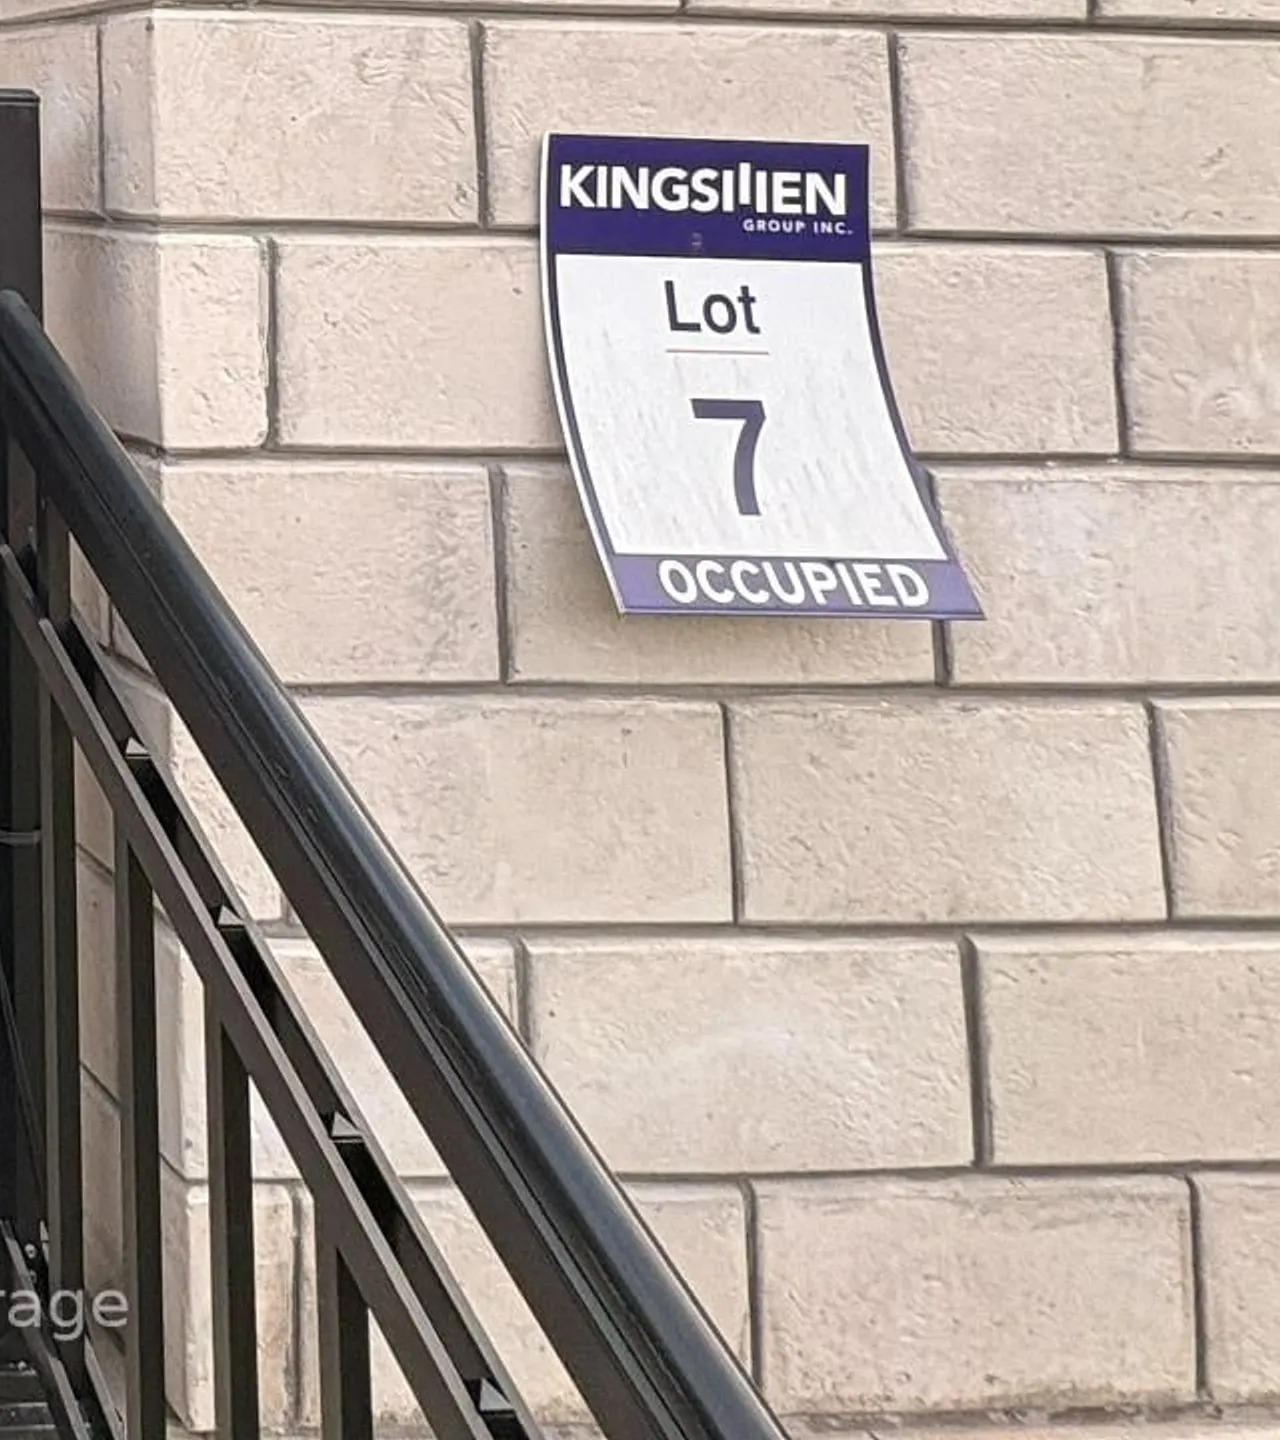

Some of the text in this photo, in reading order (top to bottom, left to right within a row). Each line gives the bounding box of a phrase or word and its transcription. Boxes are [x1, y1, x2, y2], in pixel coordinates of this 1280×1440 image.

[742, 218, 855, 236] GROUP INC.
[663, 280, 761, 334] Lot
[690, 397, 767, 517] 7
[657, 560, 930, 608] OCCUPIED
